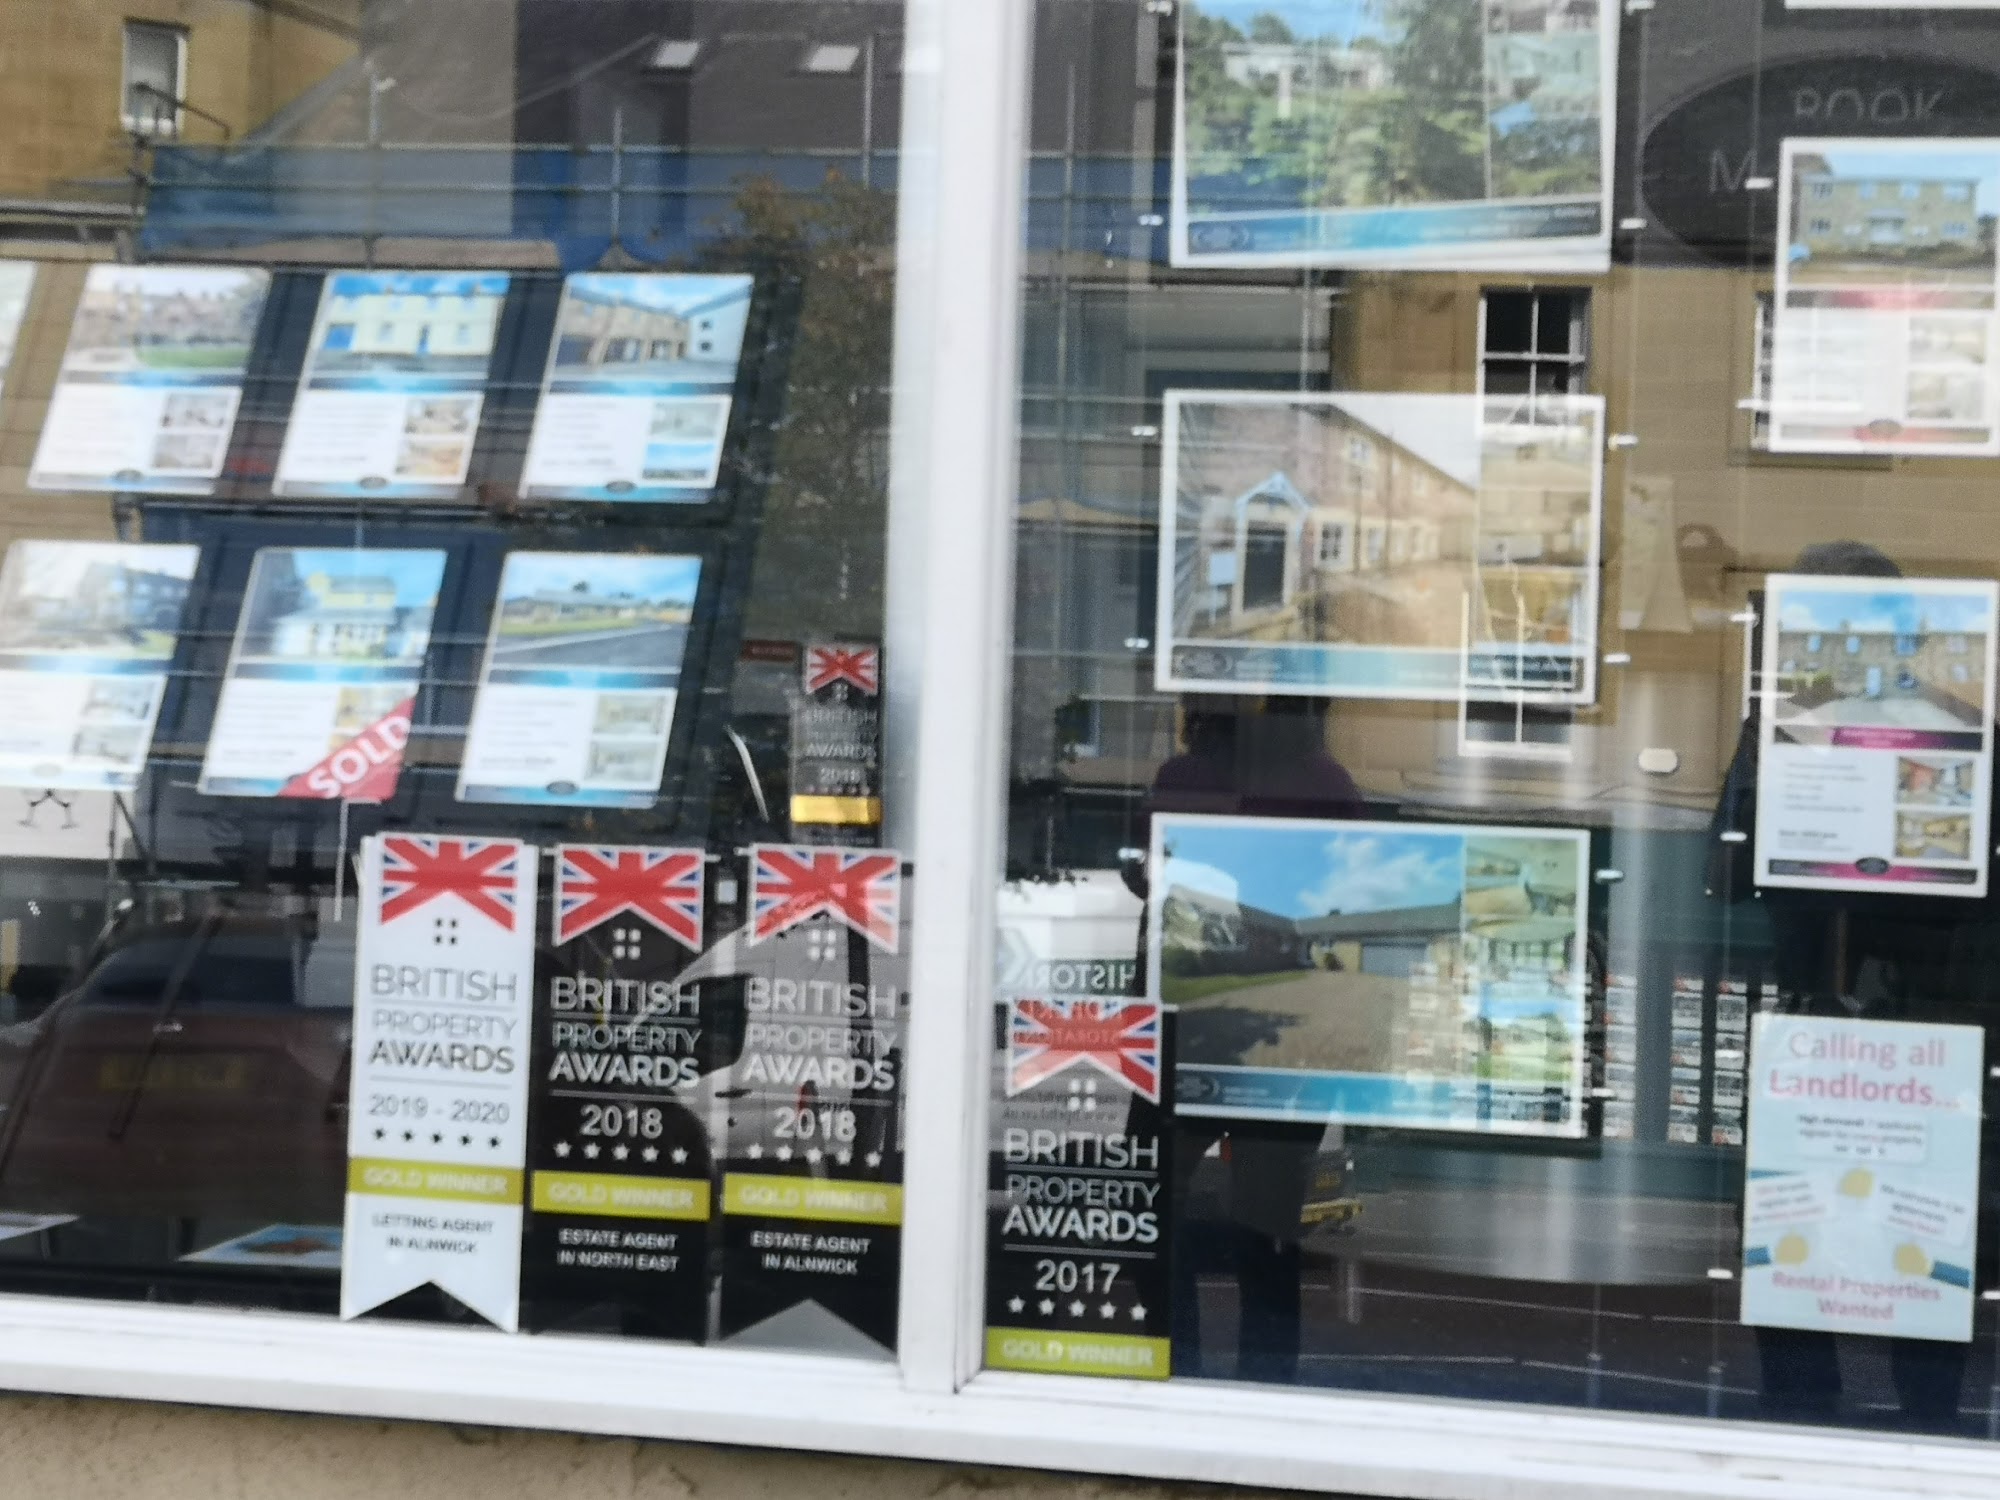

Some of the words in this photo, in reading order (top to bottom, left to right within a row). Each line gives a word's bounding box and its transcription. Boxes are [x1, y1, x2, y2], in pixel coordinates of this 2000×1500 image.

[307, 716, 411, 799] SOLD
[370, 963, 517, 1002] BRITISH
[550, 976, 700, 1016] BRITISH
[744, 977, 897, 1018] BRITISH
[372, 1008, 517, 1040] PROPERTY
[552, 1021, 702, 1054] PROPERTY
[749, 1022, 898, 1056] PROPERTY
[368, 1038, 515, 1074] AWARDS
[1789, 1031, 1897, 1070] Calling
[1909, 1036, 1946, 1067] all
[548, 1051, 700, 1088] AWARDS
[742, 1053, 895, 1092] AWARDS
[368, 1093, 429, 1119] 2019
[450, 1098, 510, 1124] 2020
[580, 1104, 663, 1139] 2018
[774, 1106, 857, 1142] 2018
[1005, 1128, 1159, 1170] BRITISH
[364, 1166, 423, 1189] GOLD
[426, 1172, 508, 1195] WINNER
[548, 1182, 608, 1206] GOLD
[612, 1187, 694, 1211] WINNER
[1006, 1174, 1161, 1208] PROPERTY
[740, 1185, 800, 1210] GOLD
[804, 1189, 888, 1215] WINNER
[372, 1213, 439, 1231] LETTING
[442, 1219, 494, 1233] AGENT
[558, 1228, 620, 1248] ESTATE
[623, 1232, 678, 1250] AGENT
[1001, 1204, 1159, 1244] AWARDS
[389, 1235, 404, 1248] IN
[408, 1237, 477, 1254] ALNWICK
[750, 1230, 812, 1251] ESTATE
[814, 1236, 871, 1254] AGENT
[556, 1250, 576, 1266] IN
[578, 1251, 634, 1269] NORTH
[636, 1254, 680, 1272] EAST
[762, 1253, 781, 1269] IN
[784, 1255, 858, 1275] ALNWICK
[1035, 1258, 1121, 1294] 2017
[1772, 1271, 1836, 1292] Rental
[1840, 1277, 1941, 1300] Properties
[1818, 1299, 1894, 1321] Wanted
[1003, 1339, 1064, 1362] GOLD
[1069, 1344, 1153, 1369] WINNER
